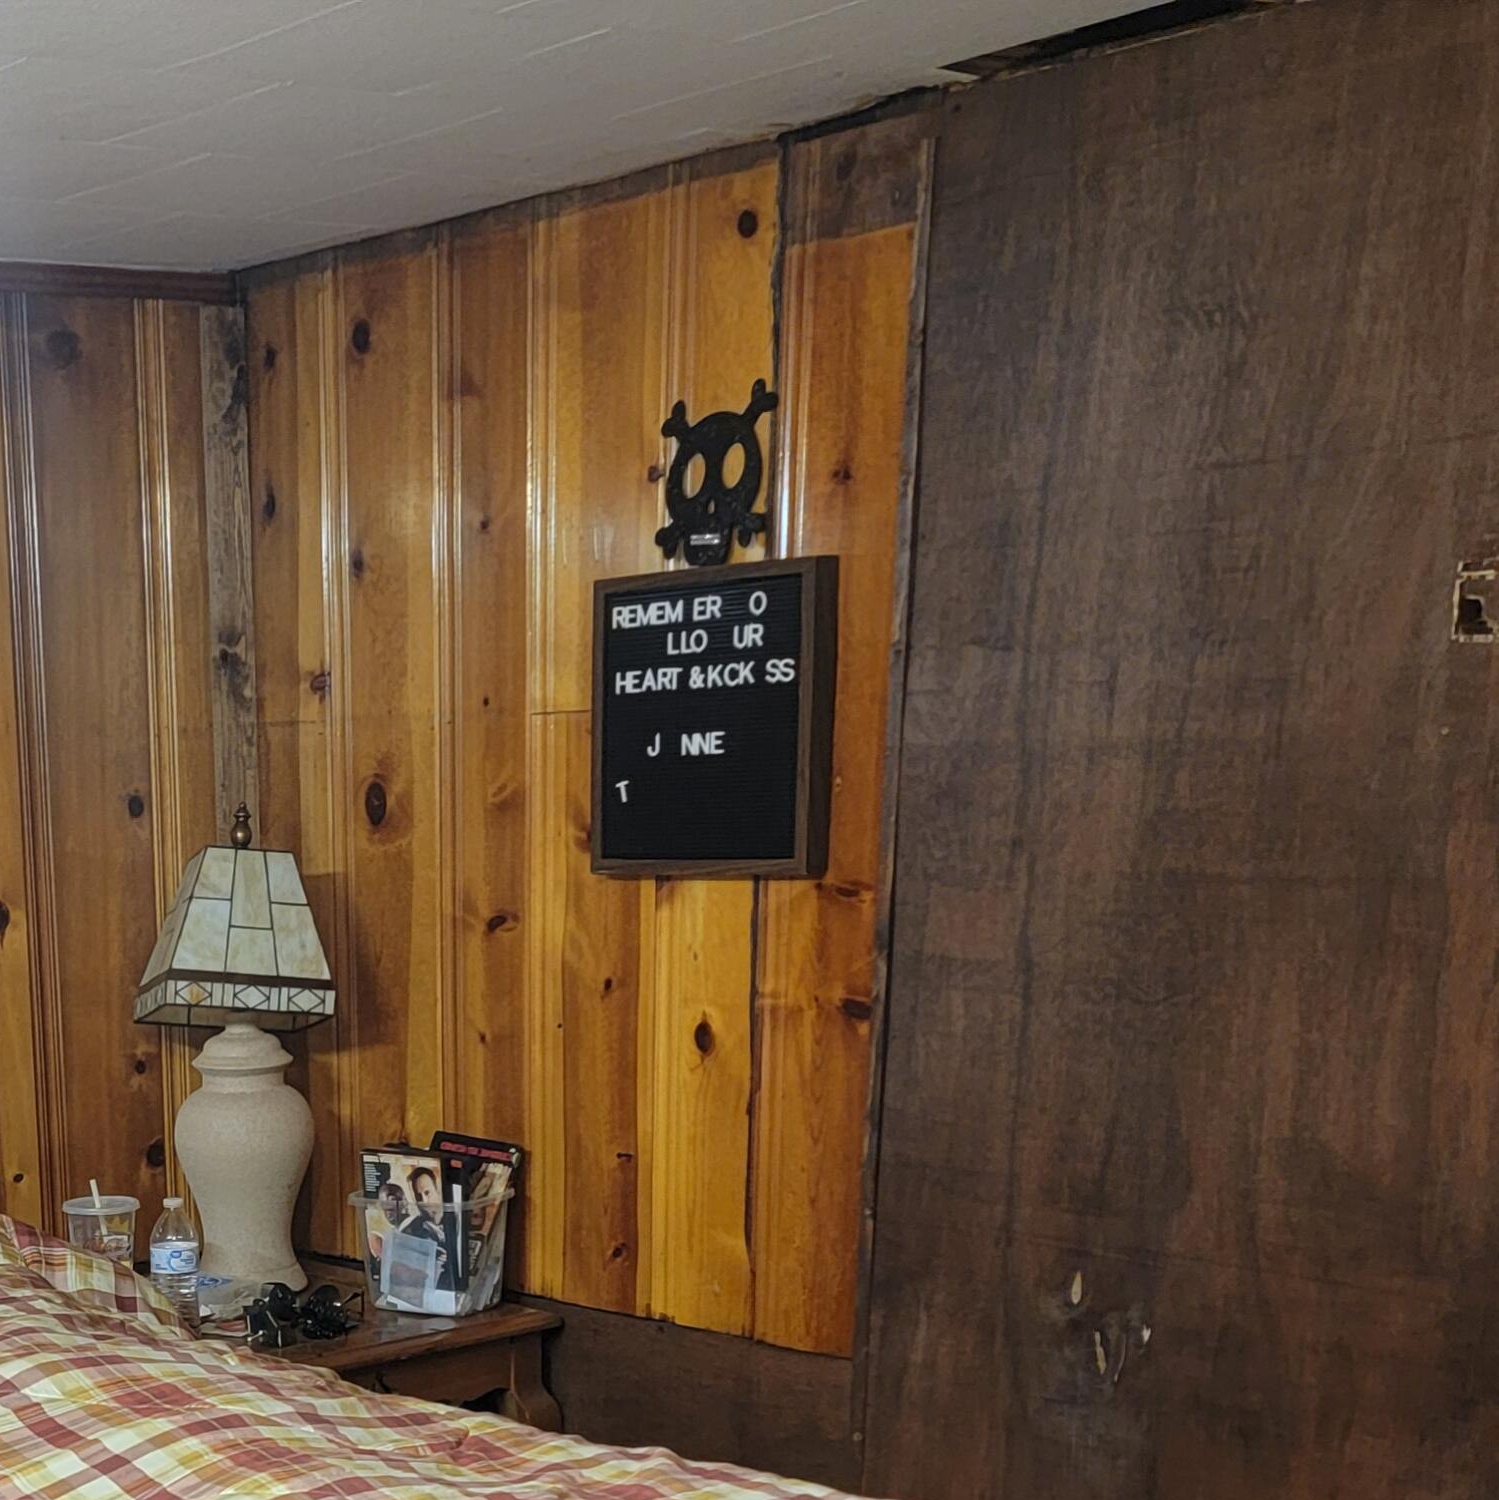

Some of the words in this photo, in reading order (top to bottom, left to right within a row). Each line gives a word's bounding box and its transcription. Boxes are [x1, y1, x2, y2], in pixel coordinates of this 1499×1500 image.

[612, 600, 683, 629] REMEM
[749, 590, 768, 616] O
[667, 630, 708, 655] LLO
[733, 623, 765, 649] UR
[615, 667, 683, 695] HEART
[765, 659, 796, 684] SS
[646, 732, 661, 757] J
[681, 731, 727, 756] NNE
[615, 780, 631, 804] T
